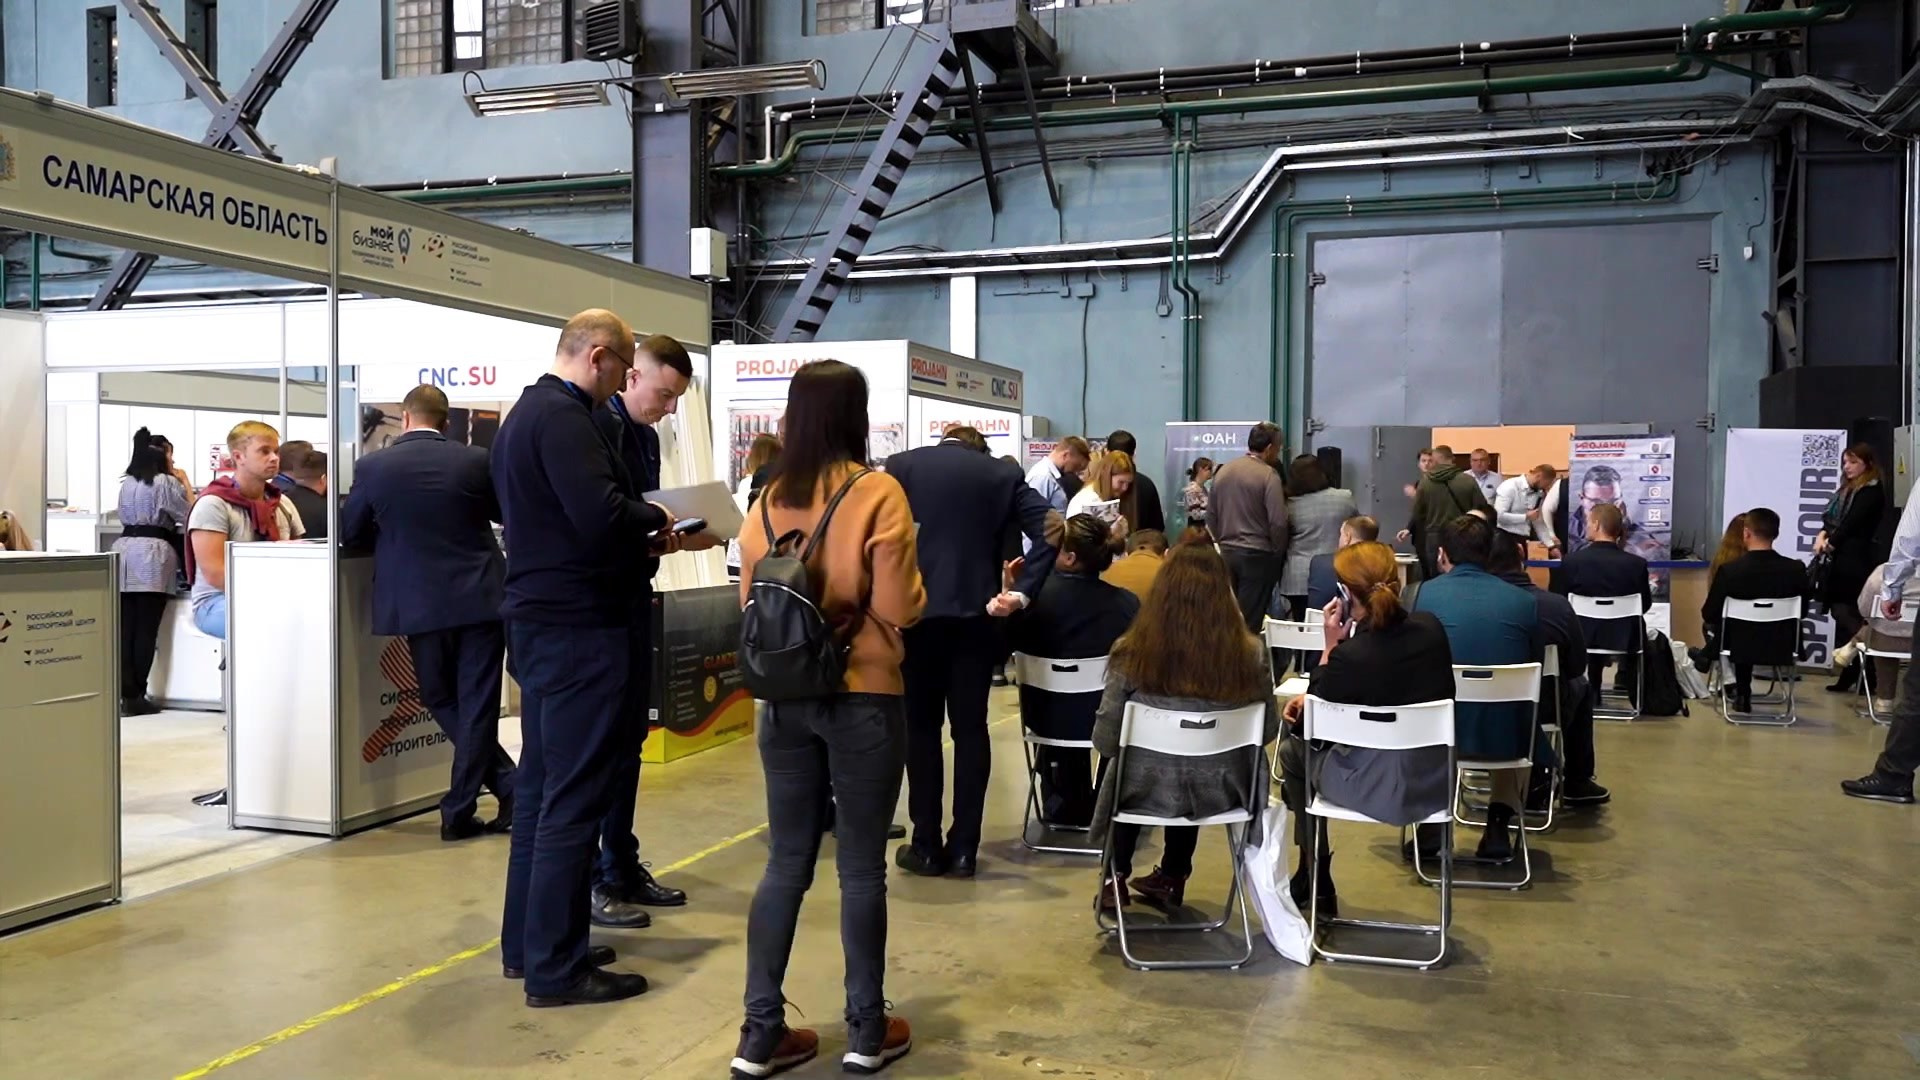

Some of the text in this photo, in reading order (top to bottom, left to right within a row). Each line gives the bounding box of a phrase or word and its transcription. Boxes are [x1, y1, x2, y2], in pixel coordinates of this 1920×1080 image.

[43, 155, 328, 245] САМАРСКАЯ ОБЛАСТЬ
[352, 230, 394, 253] бизнес
[418, 365, 496, 387] CNC.SU
[911, 357, 947, 380] PROJAHN
[991, 377, 1018, 400] CNC.SU
[1202, 432, 1236, 444] ФАН
[1796, 468, 1838, 664] SPA FOUR
[381, 731, 449, 757] строитель
